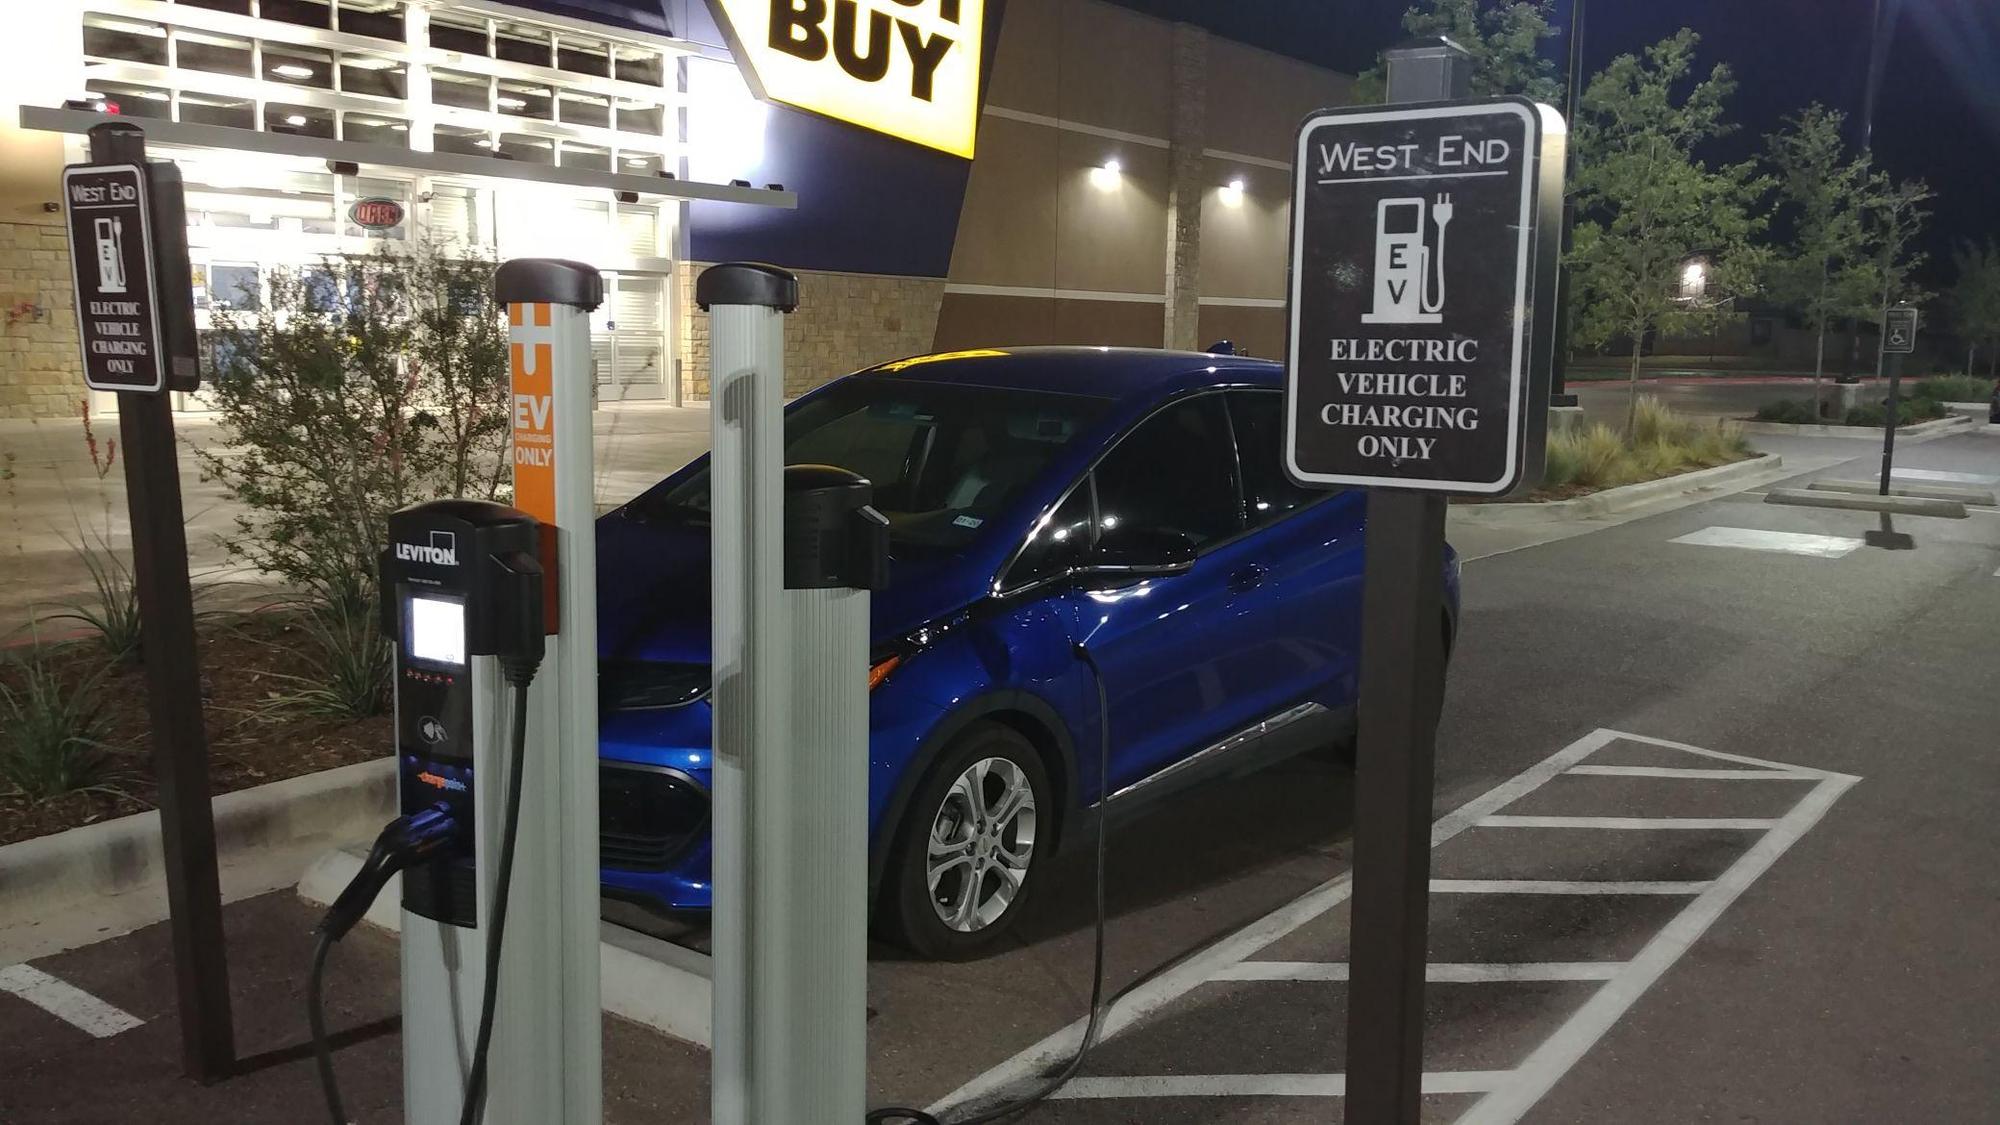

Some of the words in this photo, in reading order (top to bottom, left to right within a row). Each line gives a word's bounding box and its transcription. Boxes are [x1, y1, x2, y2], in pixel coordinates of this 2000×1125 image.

[768, 0, 954, 103] BUY
[1320, 142, 1419, 172] WEST
[1438, 136, 1510, 166] END
[72, 183, 106, 202] WEST
[111, 182, 136, 200] END
[90, 302, 140, 316] ELECTRIC
[94, 322, 140, 336] VEHICLE
[91, 339, 147, 356] CHARGING
[1330, 338, 1479, 363] ELECTRIC
[107, 359, 134, 373] ONLY
[1336, 372, 1466, 397] VEHICLE
[514, 394, 551, 430] EV
[1320, 403, 1479, 430] CHARGING
[515, 446, 552, 467] ONLY
[1357, 435, 1437, 460] ONLY
[396, 543, 456, 566] LEVITON
